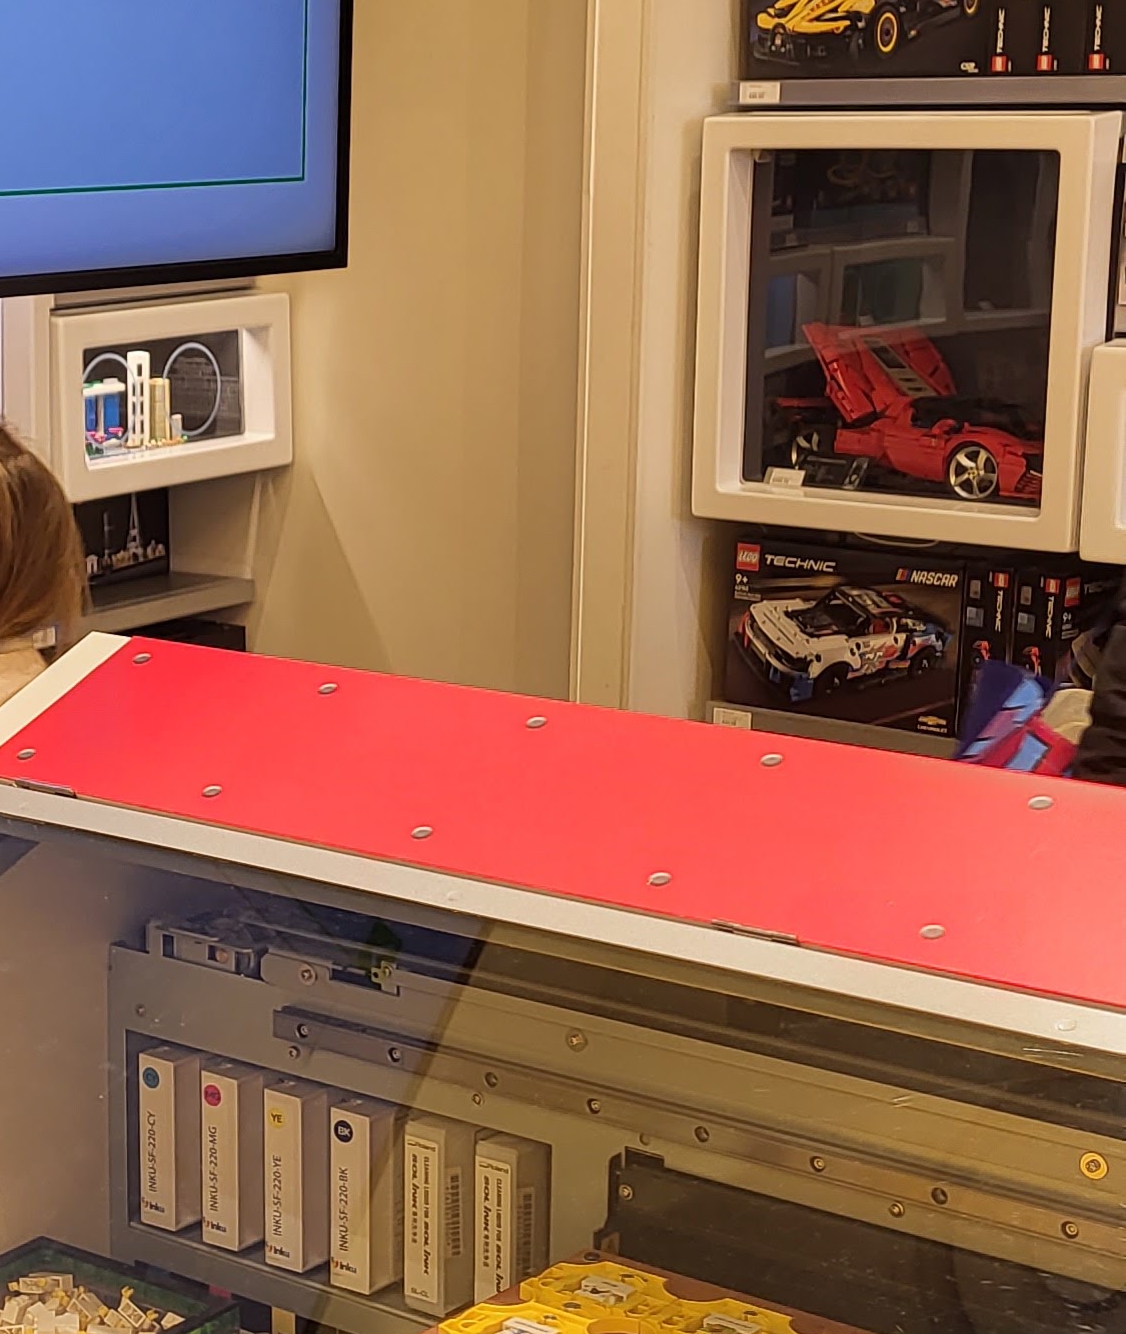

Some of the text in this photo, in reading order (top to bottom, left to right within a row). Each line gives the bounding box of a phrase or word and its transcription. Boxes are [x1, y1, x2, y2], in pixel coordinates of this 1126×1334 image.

[764, 554, 836, 572] TECHNIC
[910, 571, 958, 587] NASCAR
[271, 1113, 283, 1124] YE
[338, 1125, 351, 1137] BK
[147, 1111, 157, 1192] INKU-SF-220-CY
[208, 1126, 219, 1212] INKU-SF-220-MG
[272, 1154, 282, 1237] INKU-SF-220-YE
[339, 1167, 349, 1252] INKU-SF-220-BK
